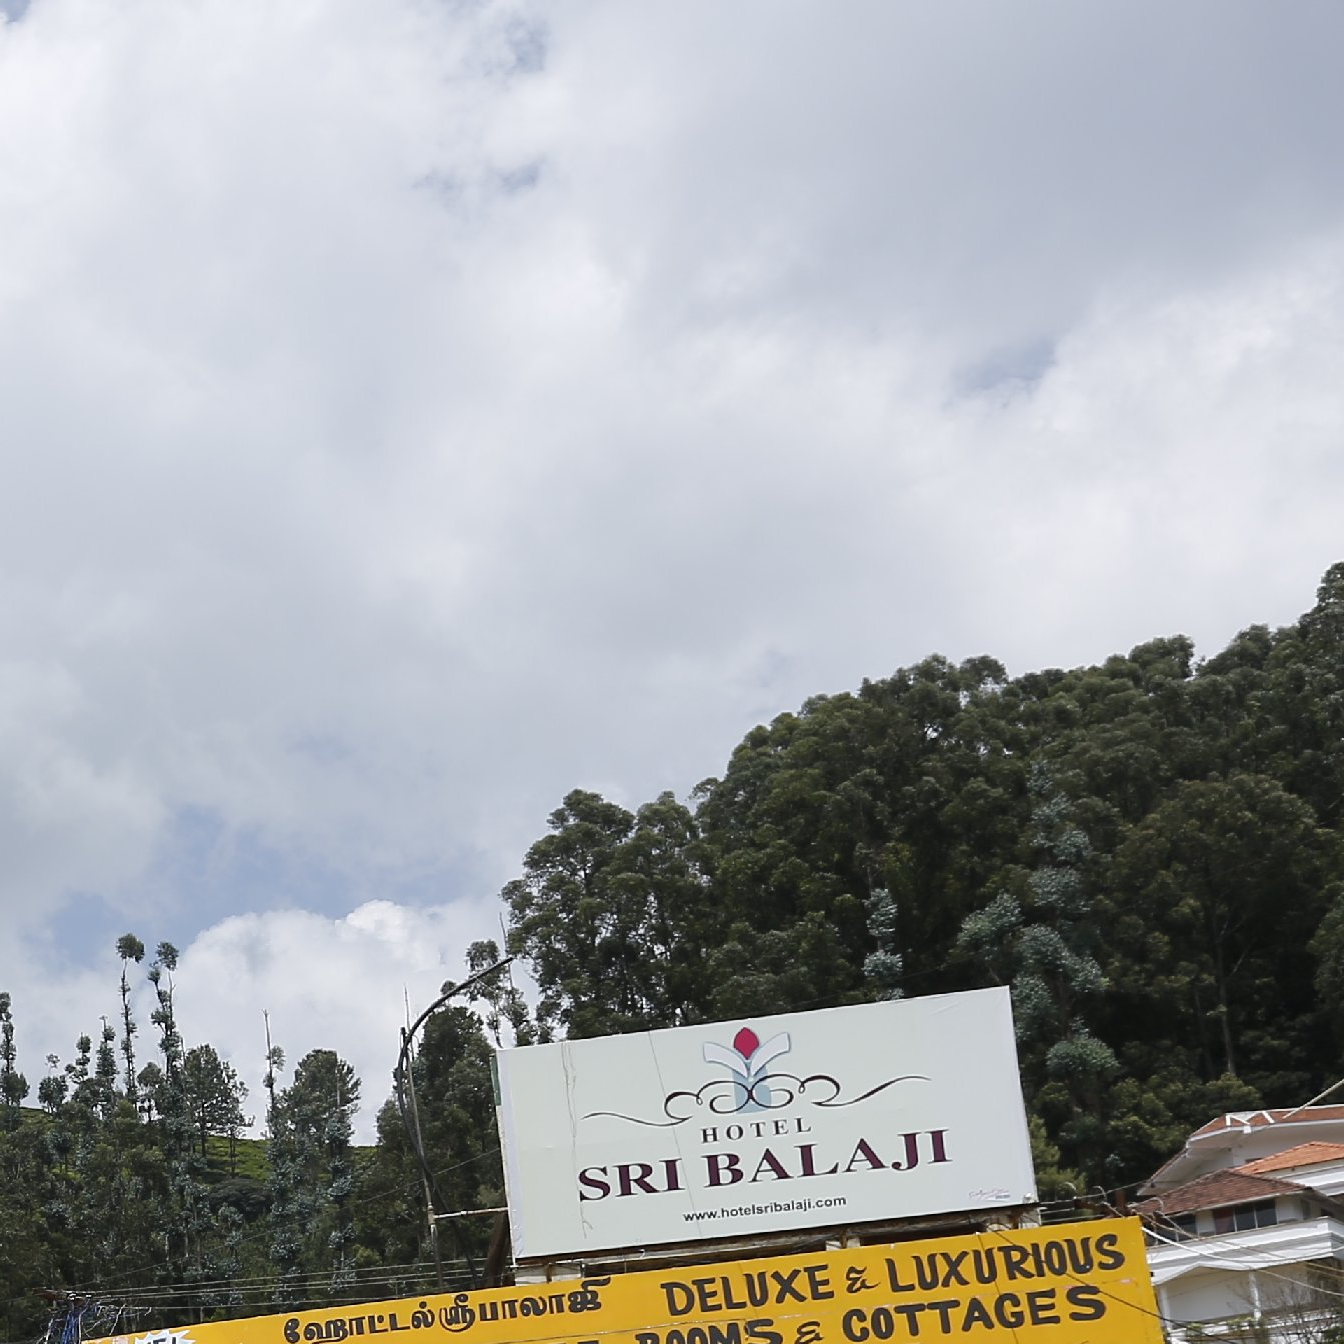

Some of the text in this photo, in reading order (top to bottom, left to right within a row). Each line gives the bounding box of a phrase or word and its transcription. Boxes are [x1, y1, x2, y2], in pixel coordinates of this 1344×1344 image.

[701, 1117, 812, 1144] HOTEL
[578, 1128, 954, 1203] SRI BALAJI
[683, 1194, 847, 1224] www.hotelsribalaji.com
[660, 1233, 1126, 1317] DELUXE & LUXURIOUS
[841, 1284, 1109, 1344] COTTAGES
